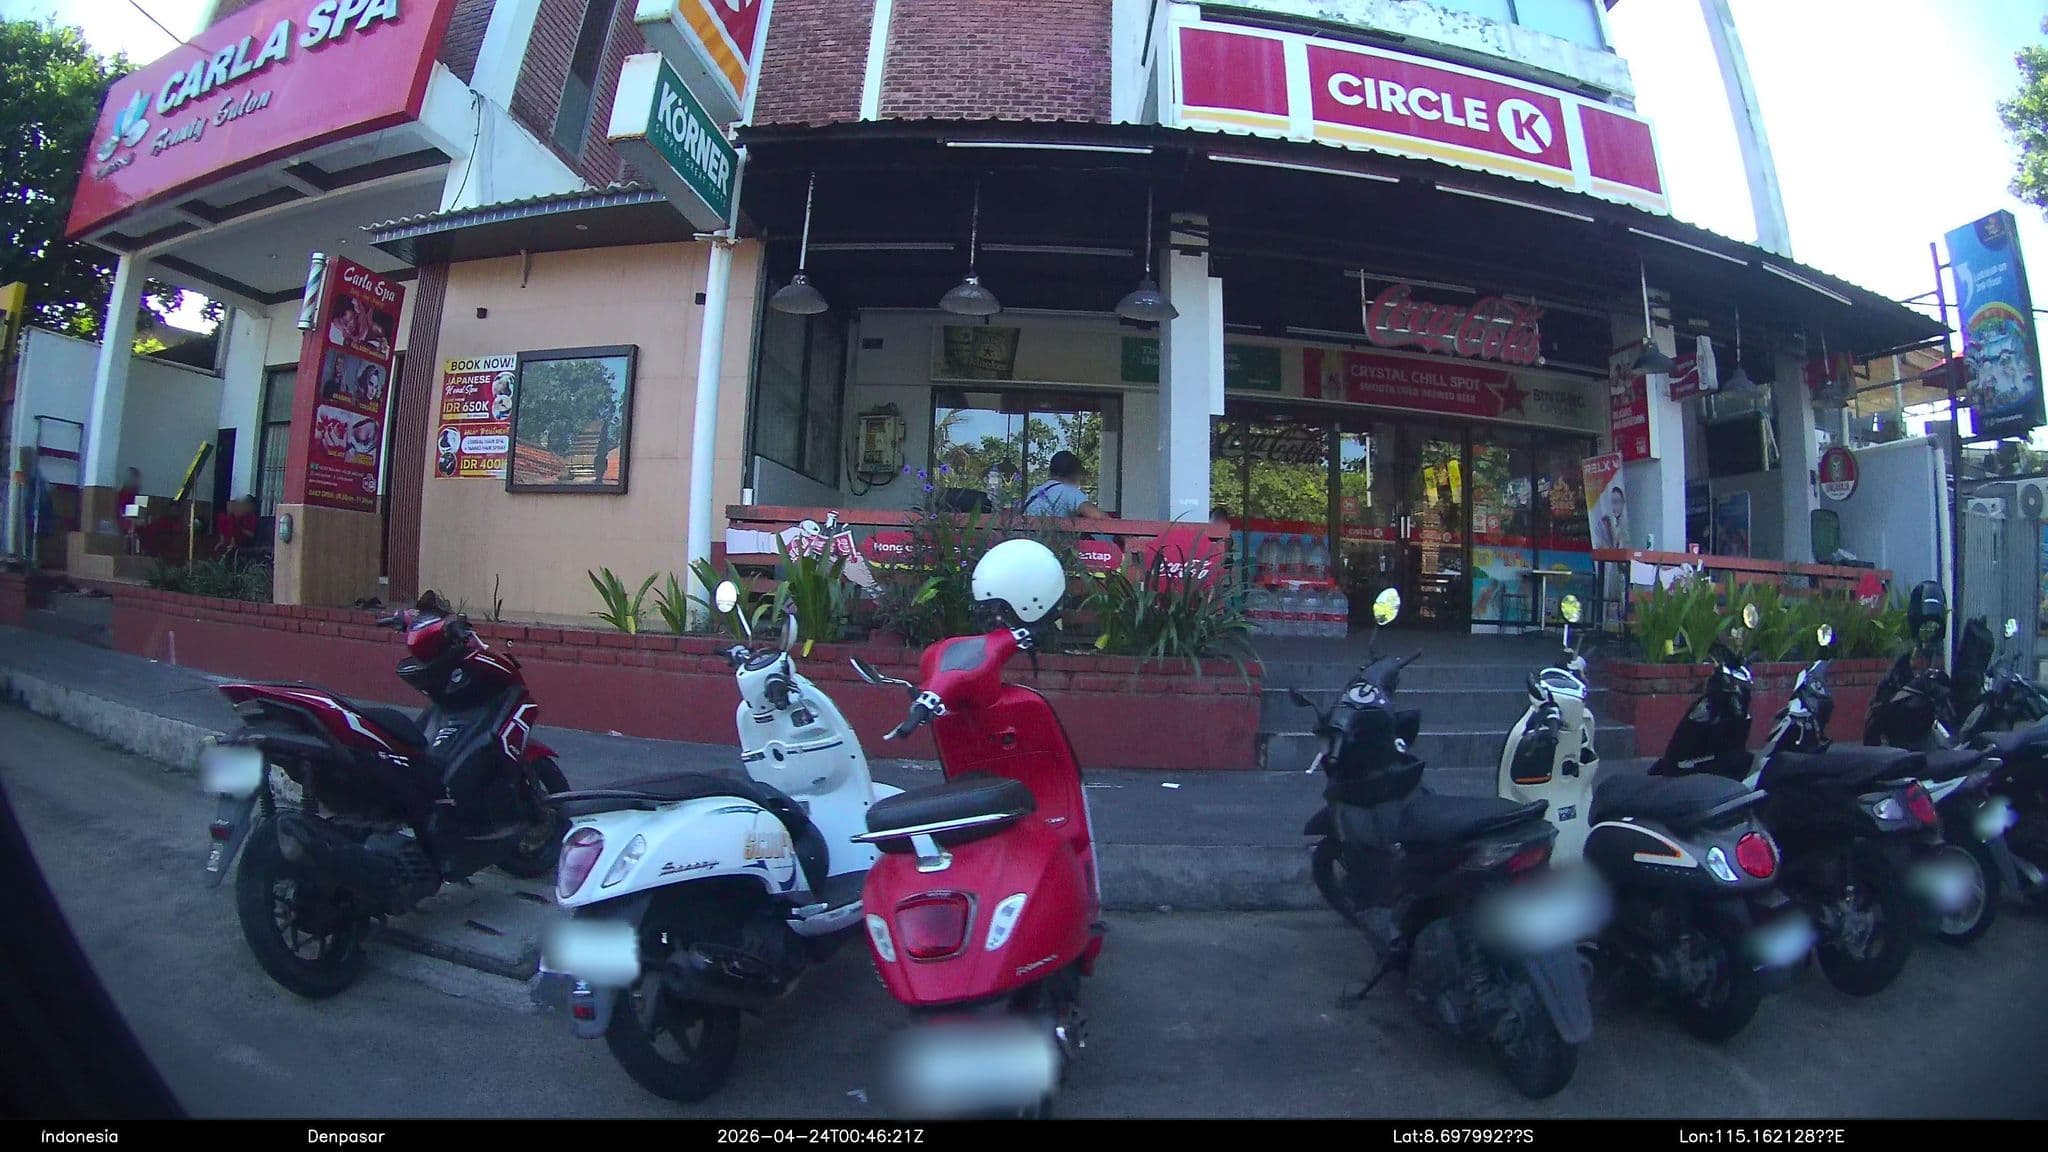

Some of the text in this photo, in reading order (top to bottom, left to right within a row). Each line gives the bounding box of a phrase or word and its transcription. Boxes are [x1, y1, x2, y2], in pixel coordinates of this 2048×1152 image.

[156, 0, 401, 114] CARLA SPA
[212, 89, 273, 127] Salon
[1328, 72, 1491, 132] CIRCLE
[655, 123, 683, 159] SIMPLY
[685, 157, 706, 185] GREAT
[657, 80, 730, 196] KÖRNER
[343, 266, 373, 292] Carla
[374, 280, 396, 303] Spa
[448, 375, 491, 385] JAPANESE
[451, 358, 514, 371] BOOK NOW!
[1350, 363, 1482, 393] CRYSTAL CHILL SPOT
[443, 400, 489, 413] IDR 650K
[460, 459, 478, 470] IDR
